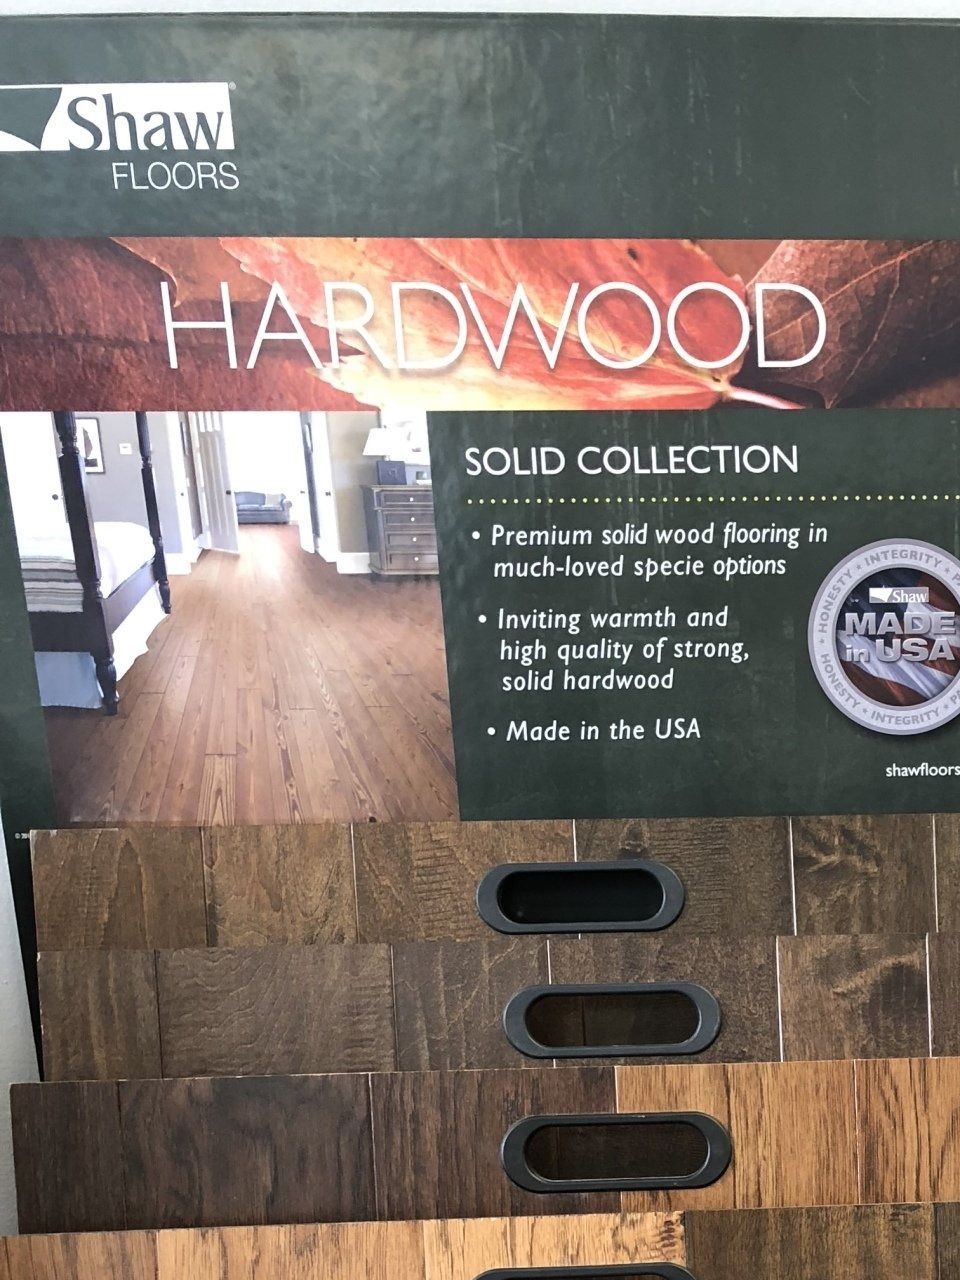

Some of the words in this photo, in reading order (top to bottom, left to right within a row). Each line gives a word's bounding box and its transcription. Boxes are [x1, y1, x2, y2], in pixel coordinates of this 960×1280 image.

[67, 93, 224, 150] Shaw
[111, 161, 240, 190] FLOORS
[160, 280, 828, 371] HARDWOOD
[464, 446, 566, 476] SOLID
[577, 444, 799, 475] COLLECTION
[491, 524, 593, 546] Premium
[601, 522, 648, 545] solid
[654, 521, 715, 545] wood
[723, 521, 801, 550] flooring
[808, 522, 828, 543] in
[493, 554, 624, 578] much-loved
[633, 554, 705, 583] specie
[713, 554, 787, 582] options
[818, 569, 853, 633] HONESTY
[865, 550, 942, 567] INTEGRITY
[892, 590, 927, 602] Shaw
[498, 607, 582, 635] Inviting
[590, 605, 676, 629] warmth
[686, 605, 729, 627] and
[844, 612, 956, 635] MADE
[500, 638, 547, 667] high
[557, 637, 634, 666] quality
[642, 636, 669, 664] of
[673, 640, 749, 664] strong,
[845, 645, 870, 662] in
[875, 638, 955, 662] USA
[502, 669, 554, 692] solid
[563, 667, 674, 690] hardwood
[821, 653, 861, 709] HONESTY
[871, 708, 940, 725] INTEGRITY
[506, 719, 571, 742] Made
[580, 720, 600, 741] in
[609, 718, 645, 740] the
[655, 717, 701, 740] USA
